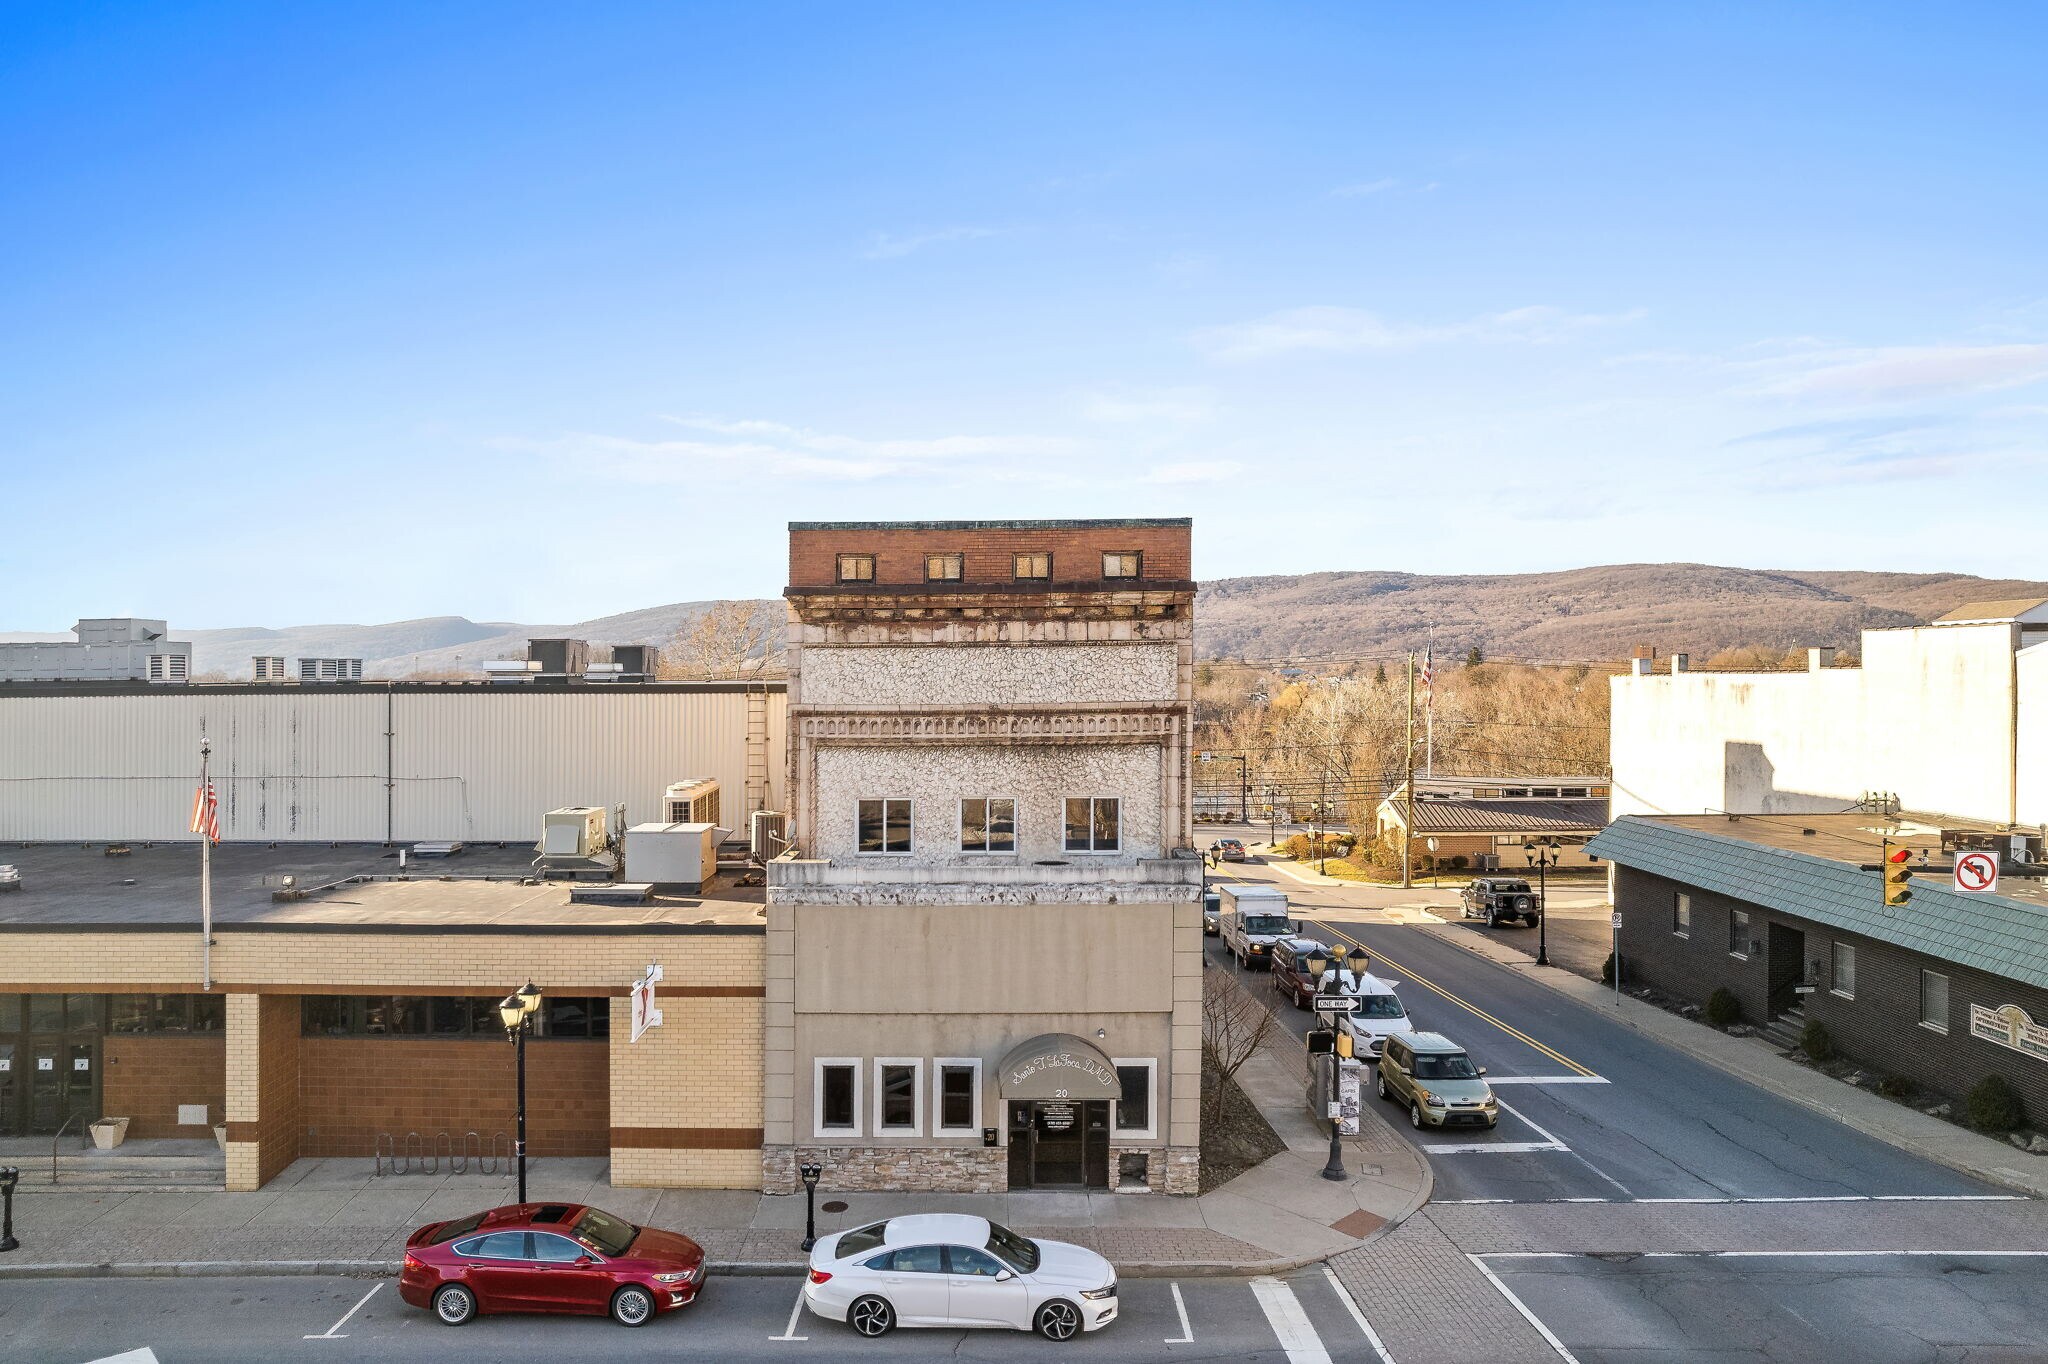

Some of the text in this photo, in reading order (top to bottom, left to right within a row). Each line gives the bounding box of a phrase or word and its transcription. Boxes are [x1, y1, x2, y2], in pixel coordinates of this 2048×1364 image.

[1319, 1000, 1348, 1008] ONE WAY
[1975, 1015, 2009, 1031] OPTOMETRIST
[1012, 1064, 1036, 1086] Santo
[1055, 1089, 1068, 1098] 20
